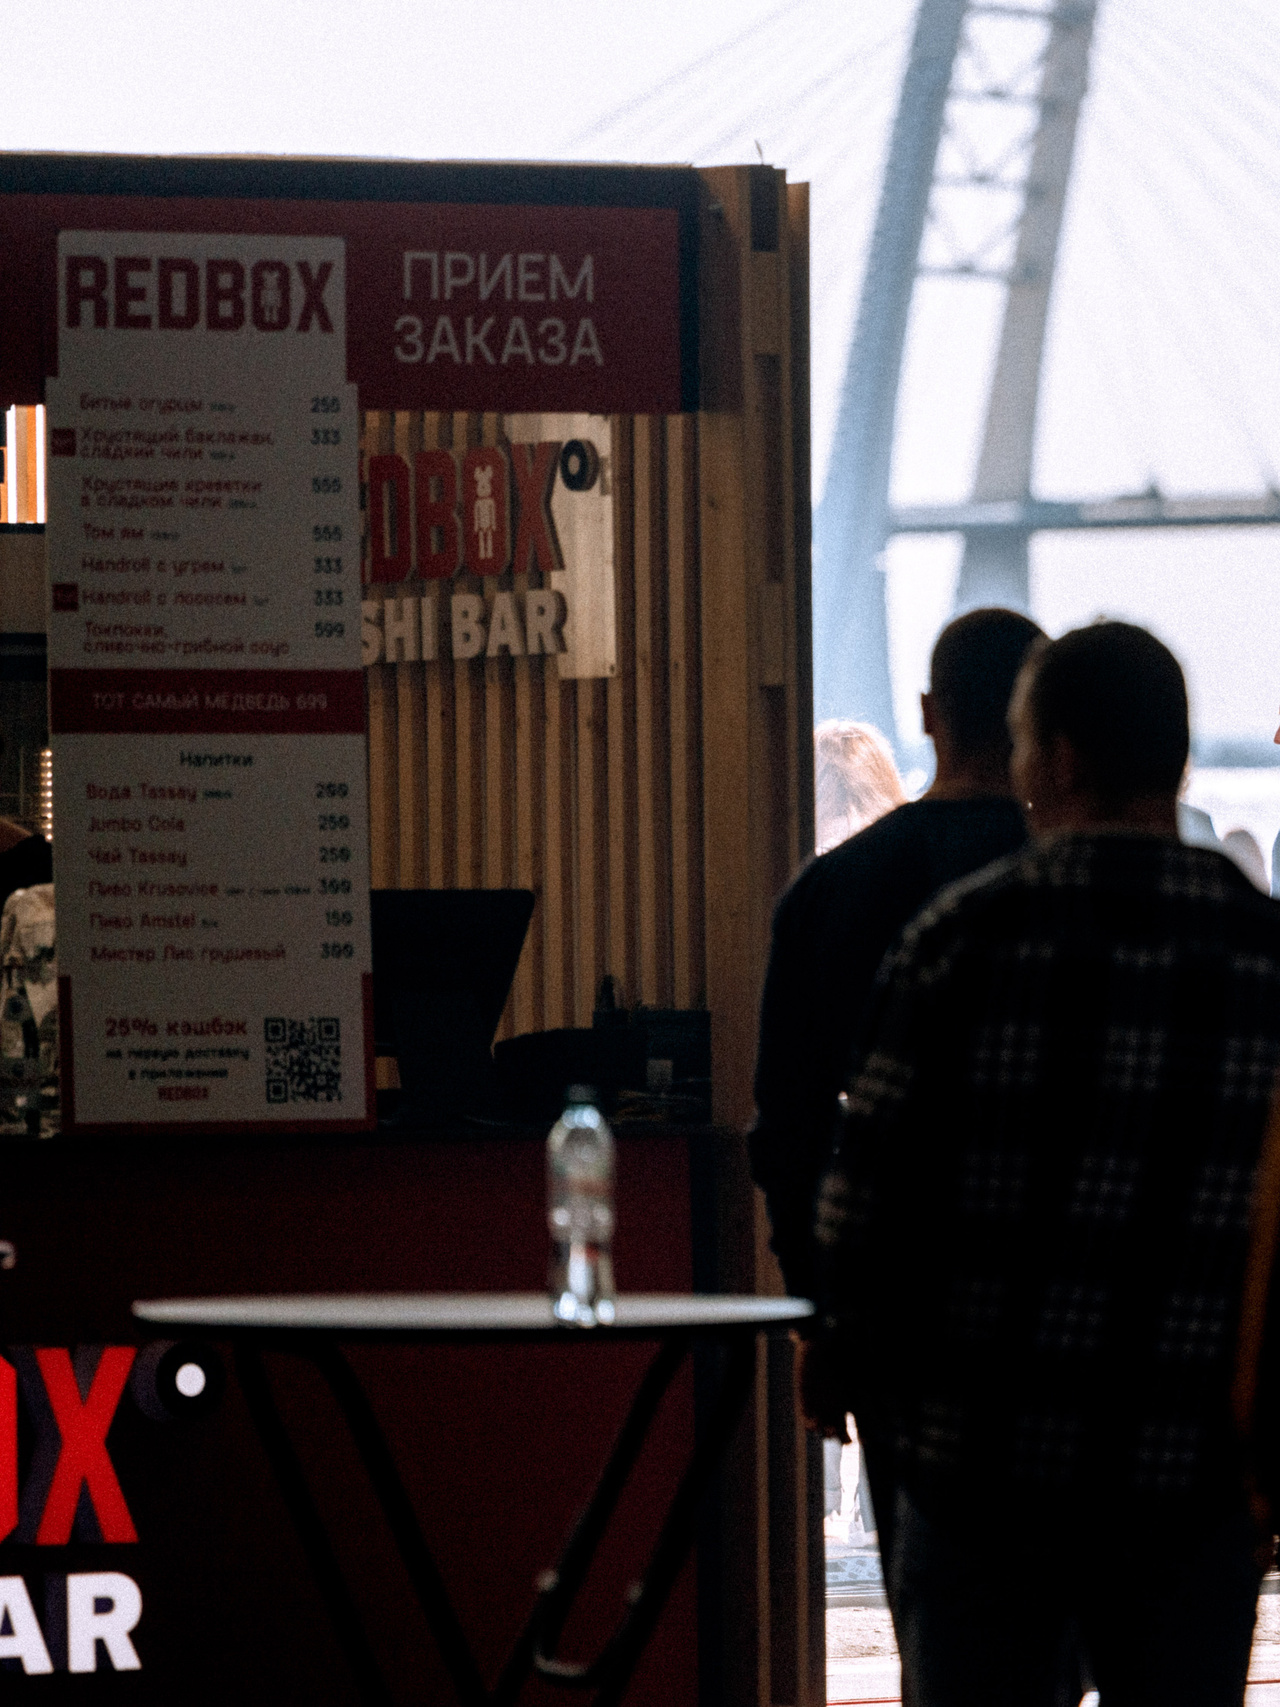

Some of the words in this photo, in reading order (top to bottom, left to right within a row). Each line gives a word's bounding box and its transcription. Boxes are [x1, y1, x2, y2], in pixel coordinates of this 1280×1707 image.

[403, 251, 596, 303] ПРИЕМ
[64, 255, 335, 333] REDBOX
[394, 315, 604, 367] ЗАКАЗА
[80, 393, 131, 411] Битые
[139, 399, 202, 415] огурцы
[80, 428, 179, 446] Хрустящий
[311, 428, 341, 446] 333
[82, 477, 178, 494] Хрустящие
[185, 481, 261, 494] креветки
[312, 477, 342, 494] 555
[81, 495, 90, 506] в
[97, 495, 173, 509] сладком
[180, 496, 222, 507] чили
[359, 442, 562, 584] DBOX
[83, 523, 115, 539] Том
[121, 527, 144, 539] ям
[312, 525, 342, 542] 555
[82, 557, 149, 573] Handroll
[172, 561, 224, 577] угрем
[313, 557, 343, 574] 333
[82, 589, 150, 605] Handroll
[314, 589, 344, 606] 333
[314, 622, 345, 638] 599
[452, 590, 563, 660] BAR
[250, 641, 290, 657] соус
[93, 693, 125, 709] ТОТ
[132, 688, 199, 709] САМЫЙ
[205, 693, 290, 711] МЕДВЕДЬ
[180, 751, 253, 767] Напитки
[86, 783, 131, 801] Вода
[139, 783, 197, 803] Tassay
[88, 815, 142, 832] Jumbo
[149, 815, 185, 832] Cola
[318, 815, 349, 831] 250
[88, 847, 121, 864] Чай
[129, 848, 187, 868] Tassay
[318, 847, 350, 864] 250
[88, 881, 131, 897] Пиво
[90, 913, 133, 929] Пиво
[140, 911, 195, 928] Amstel
[326, 910, 353, 927] 150
[91, 946, 154, 964] Мистер
[163, 945, 194, 961] Лис
[201, 943, 286, 964] грушевый
[105, 1017, 158, 1037] 25%
[166, 1016, 247, 1037] кэшбэк
[128, 1049, 180, 1062] первую
[185, 1048, 249, 1062] доставку
[158, 1086, 209, 1101] REDBOX
